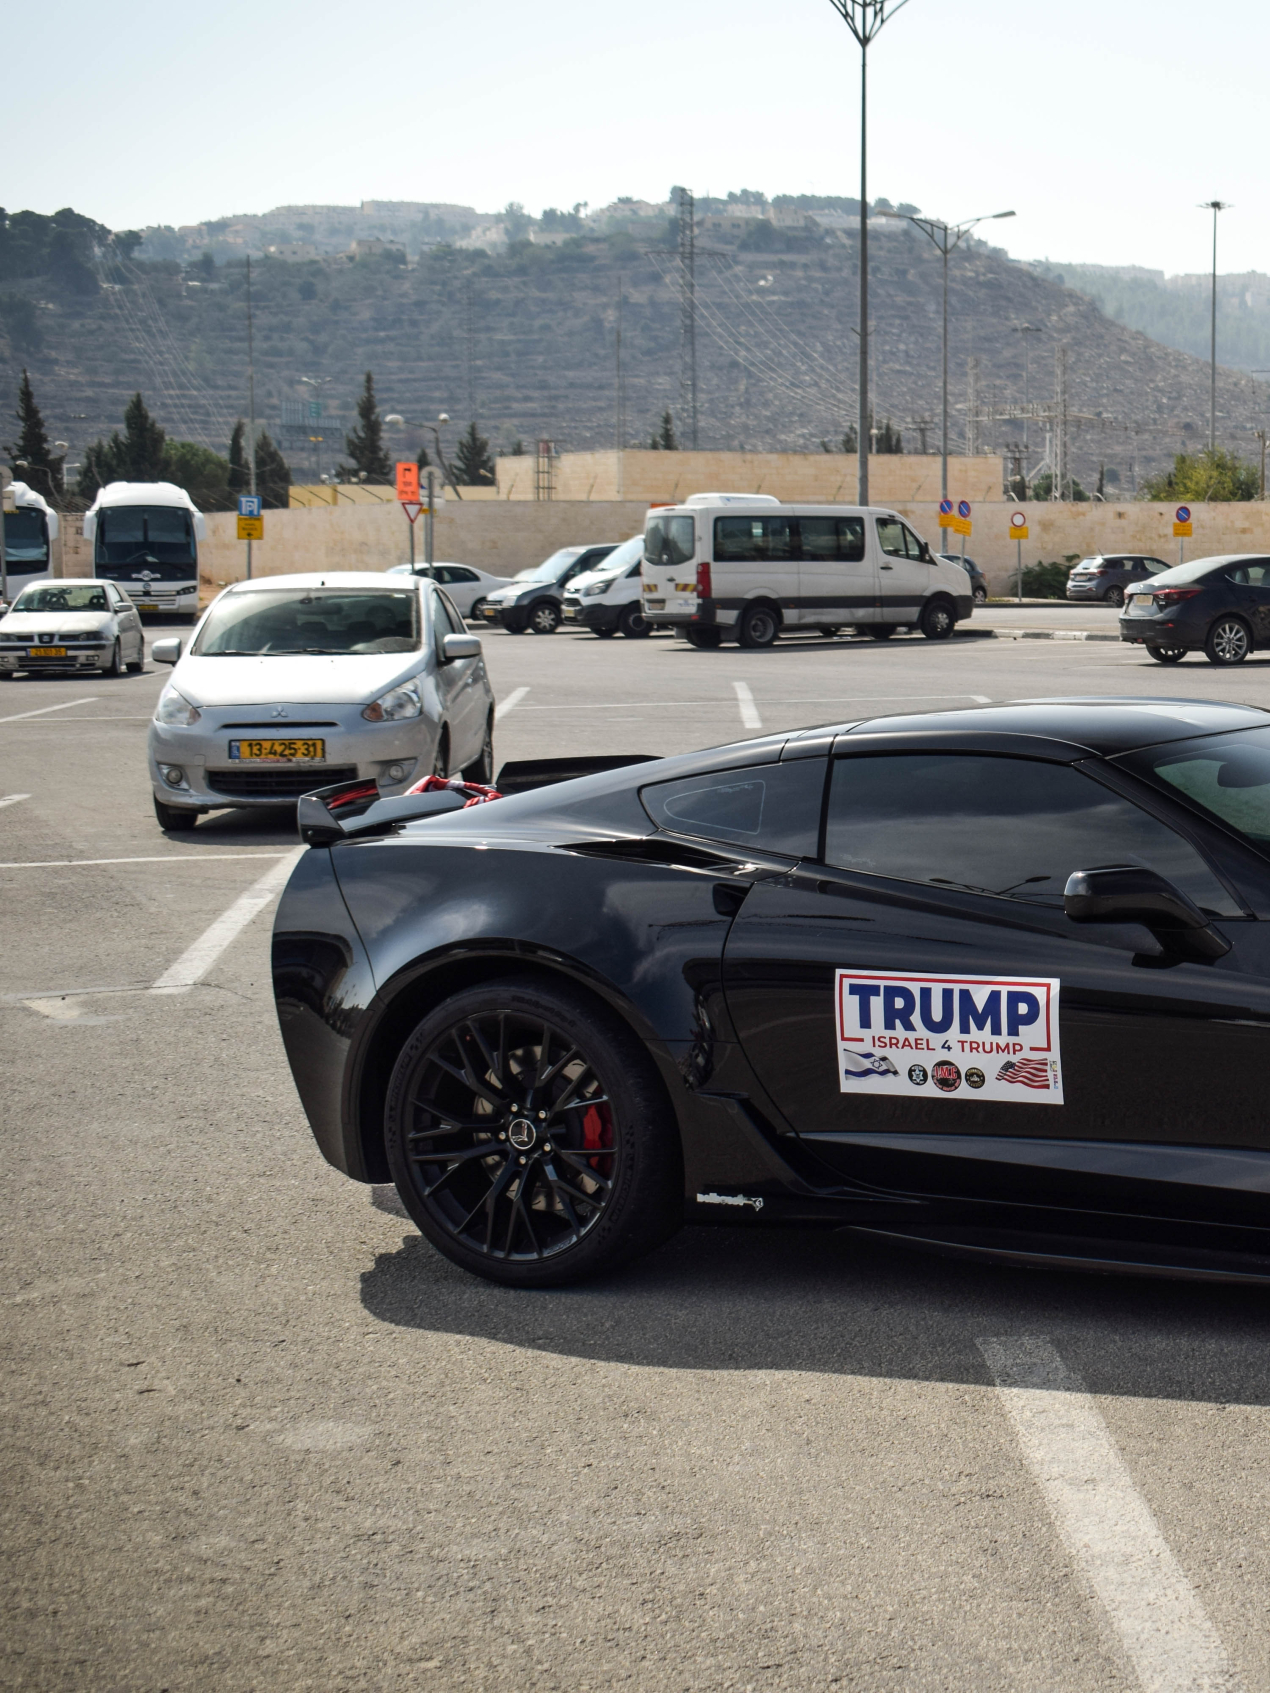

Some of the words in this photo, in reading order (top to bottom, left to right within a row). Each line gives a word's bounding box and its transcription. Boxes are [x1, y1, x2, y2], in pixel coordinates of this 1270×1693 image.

[849, 983, 1040, 1037] TRUMP
[872, 1036, 935, 1051] ISRAEL
[941, 1039, 952, 1052] 4
[958, 1040, 1023, 1055] TRUMP
